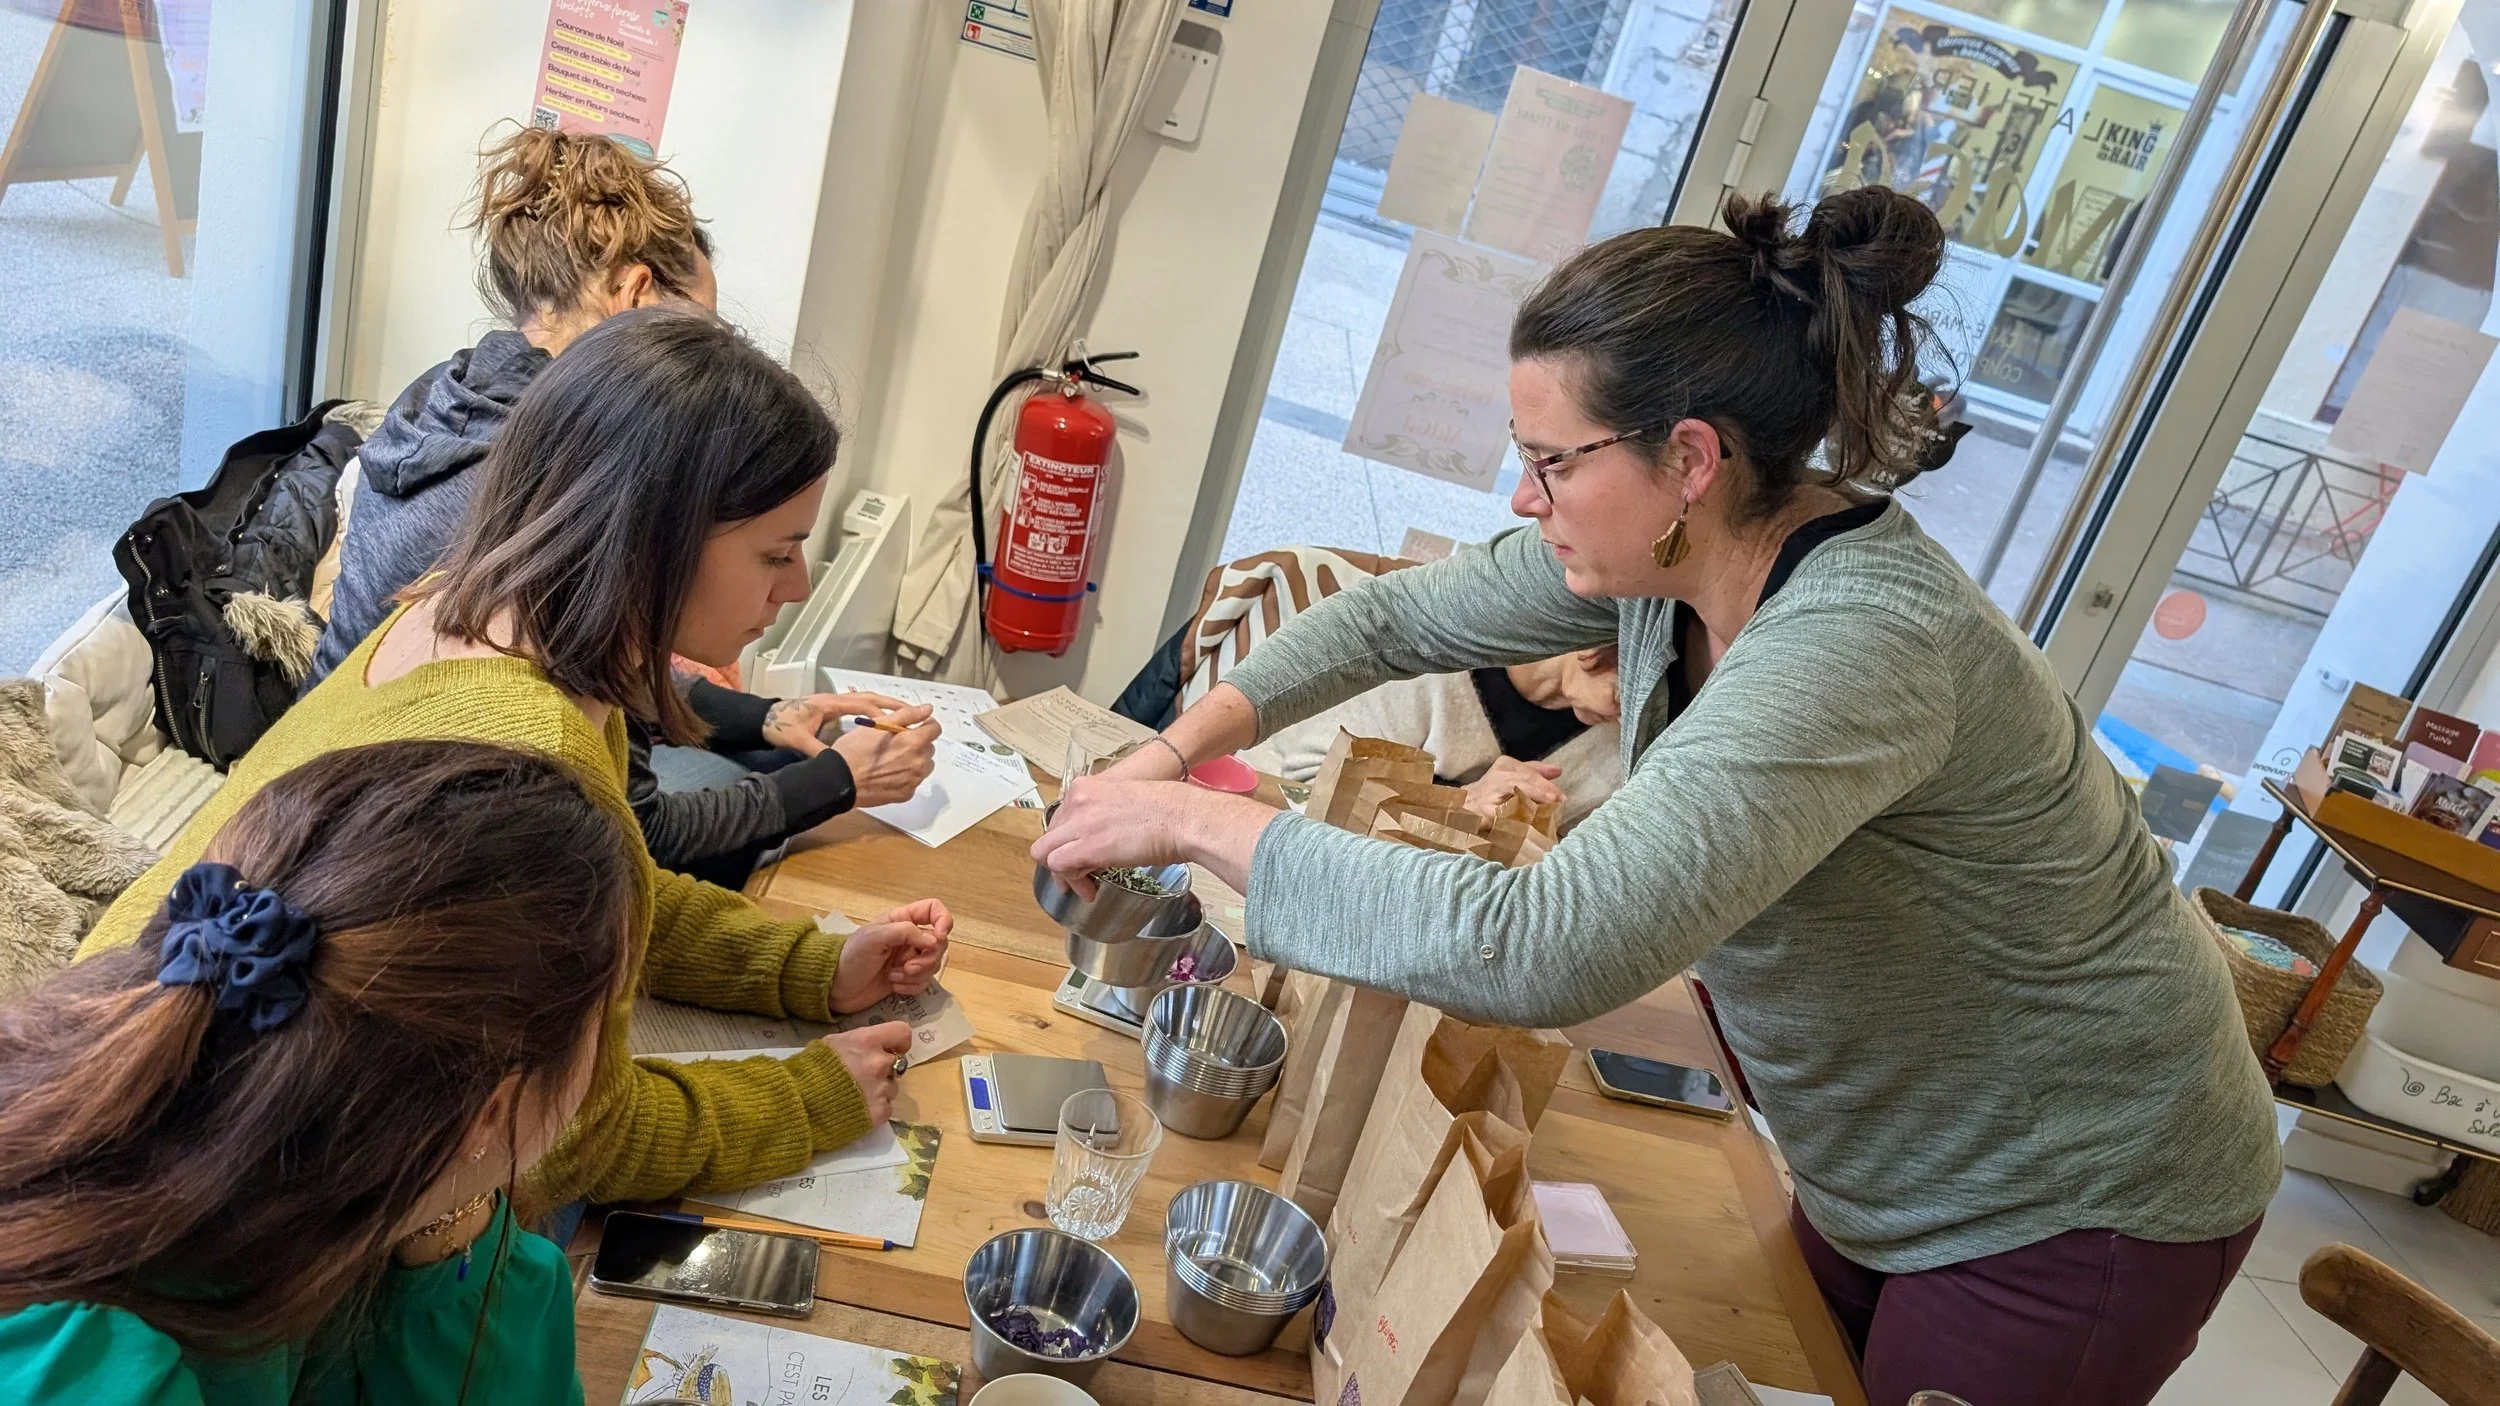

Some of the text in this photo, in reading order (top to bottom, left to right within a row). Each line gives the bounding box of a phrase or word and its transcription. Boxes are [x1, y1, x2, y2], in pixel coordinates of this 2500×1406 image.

[556, 19, 624, 48] Couronne de Noël
[551, 41, 579, 57] Centre
[580, 49, 590, 59] de
[591, 53, 611, 68] table
[612, 61, 622, 71] de
[623, 65, 641, 78] Noël
[548, 63, 580, 81] Bouquet
[581, 74, 591, 84] de
[592, 77, 615, 93] fleurs
[545, 85, 575, 101] Herbier
[576, 97, 585, 106] en
[586, 99, 608, 114] fleurs
[2104, 122, 2158, 153] KING
[2109, 146, 2148, 172] HAIR
[1030, 455, 1094, 474] EXTINCTEUR
[2426, 720, 2460, 737] Massage
[2431, 1086, 2464, 1107] Bac
[2474, 1098, 2491, 1113] à
[782, 1351, 805, 1387] C'EST
[812, 1375, 833, 1401] LES
